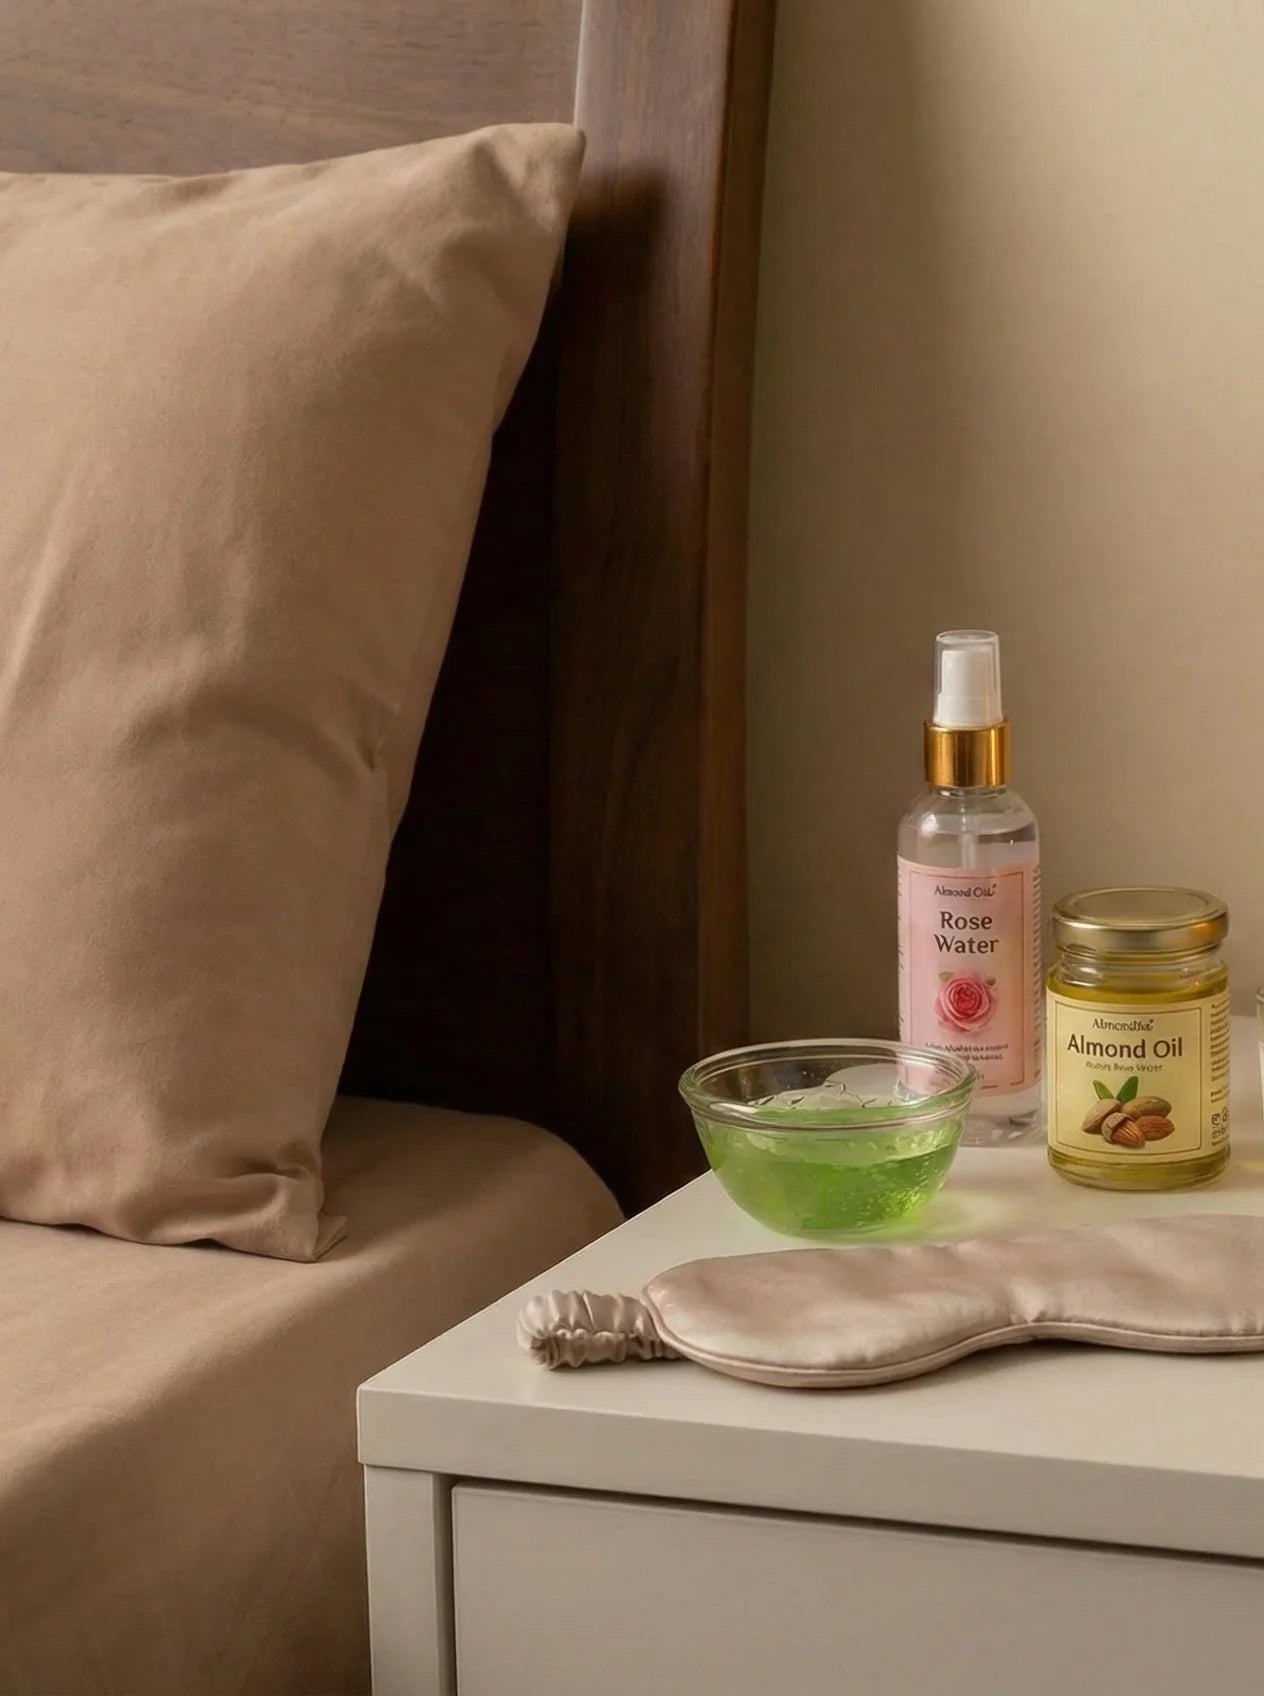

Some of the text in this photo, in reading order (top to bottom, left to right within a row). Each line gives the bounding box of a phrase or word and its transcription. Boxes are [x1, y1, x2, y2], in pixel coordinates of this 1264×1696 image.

[940, 911, 993, 931] Rose
[934, 934, 999, 954] Water
[1067, 1033, 1182, 1059] Almond Oil
